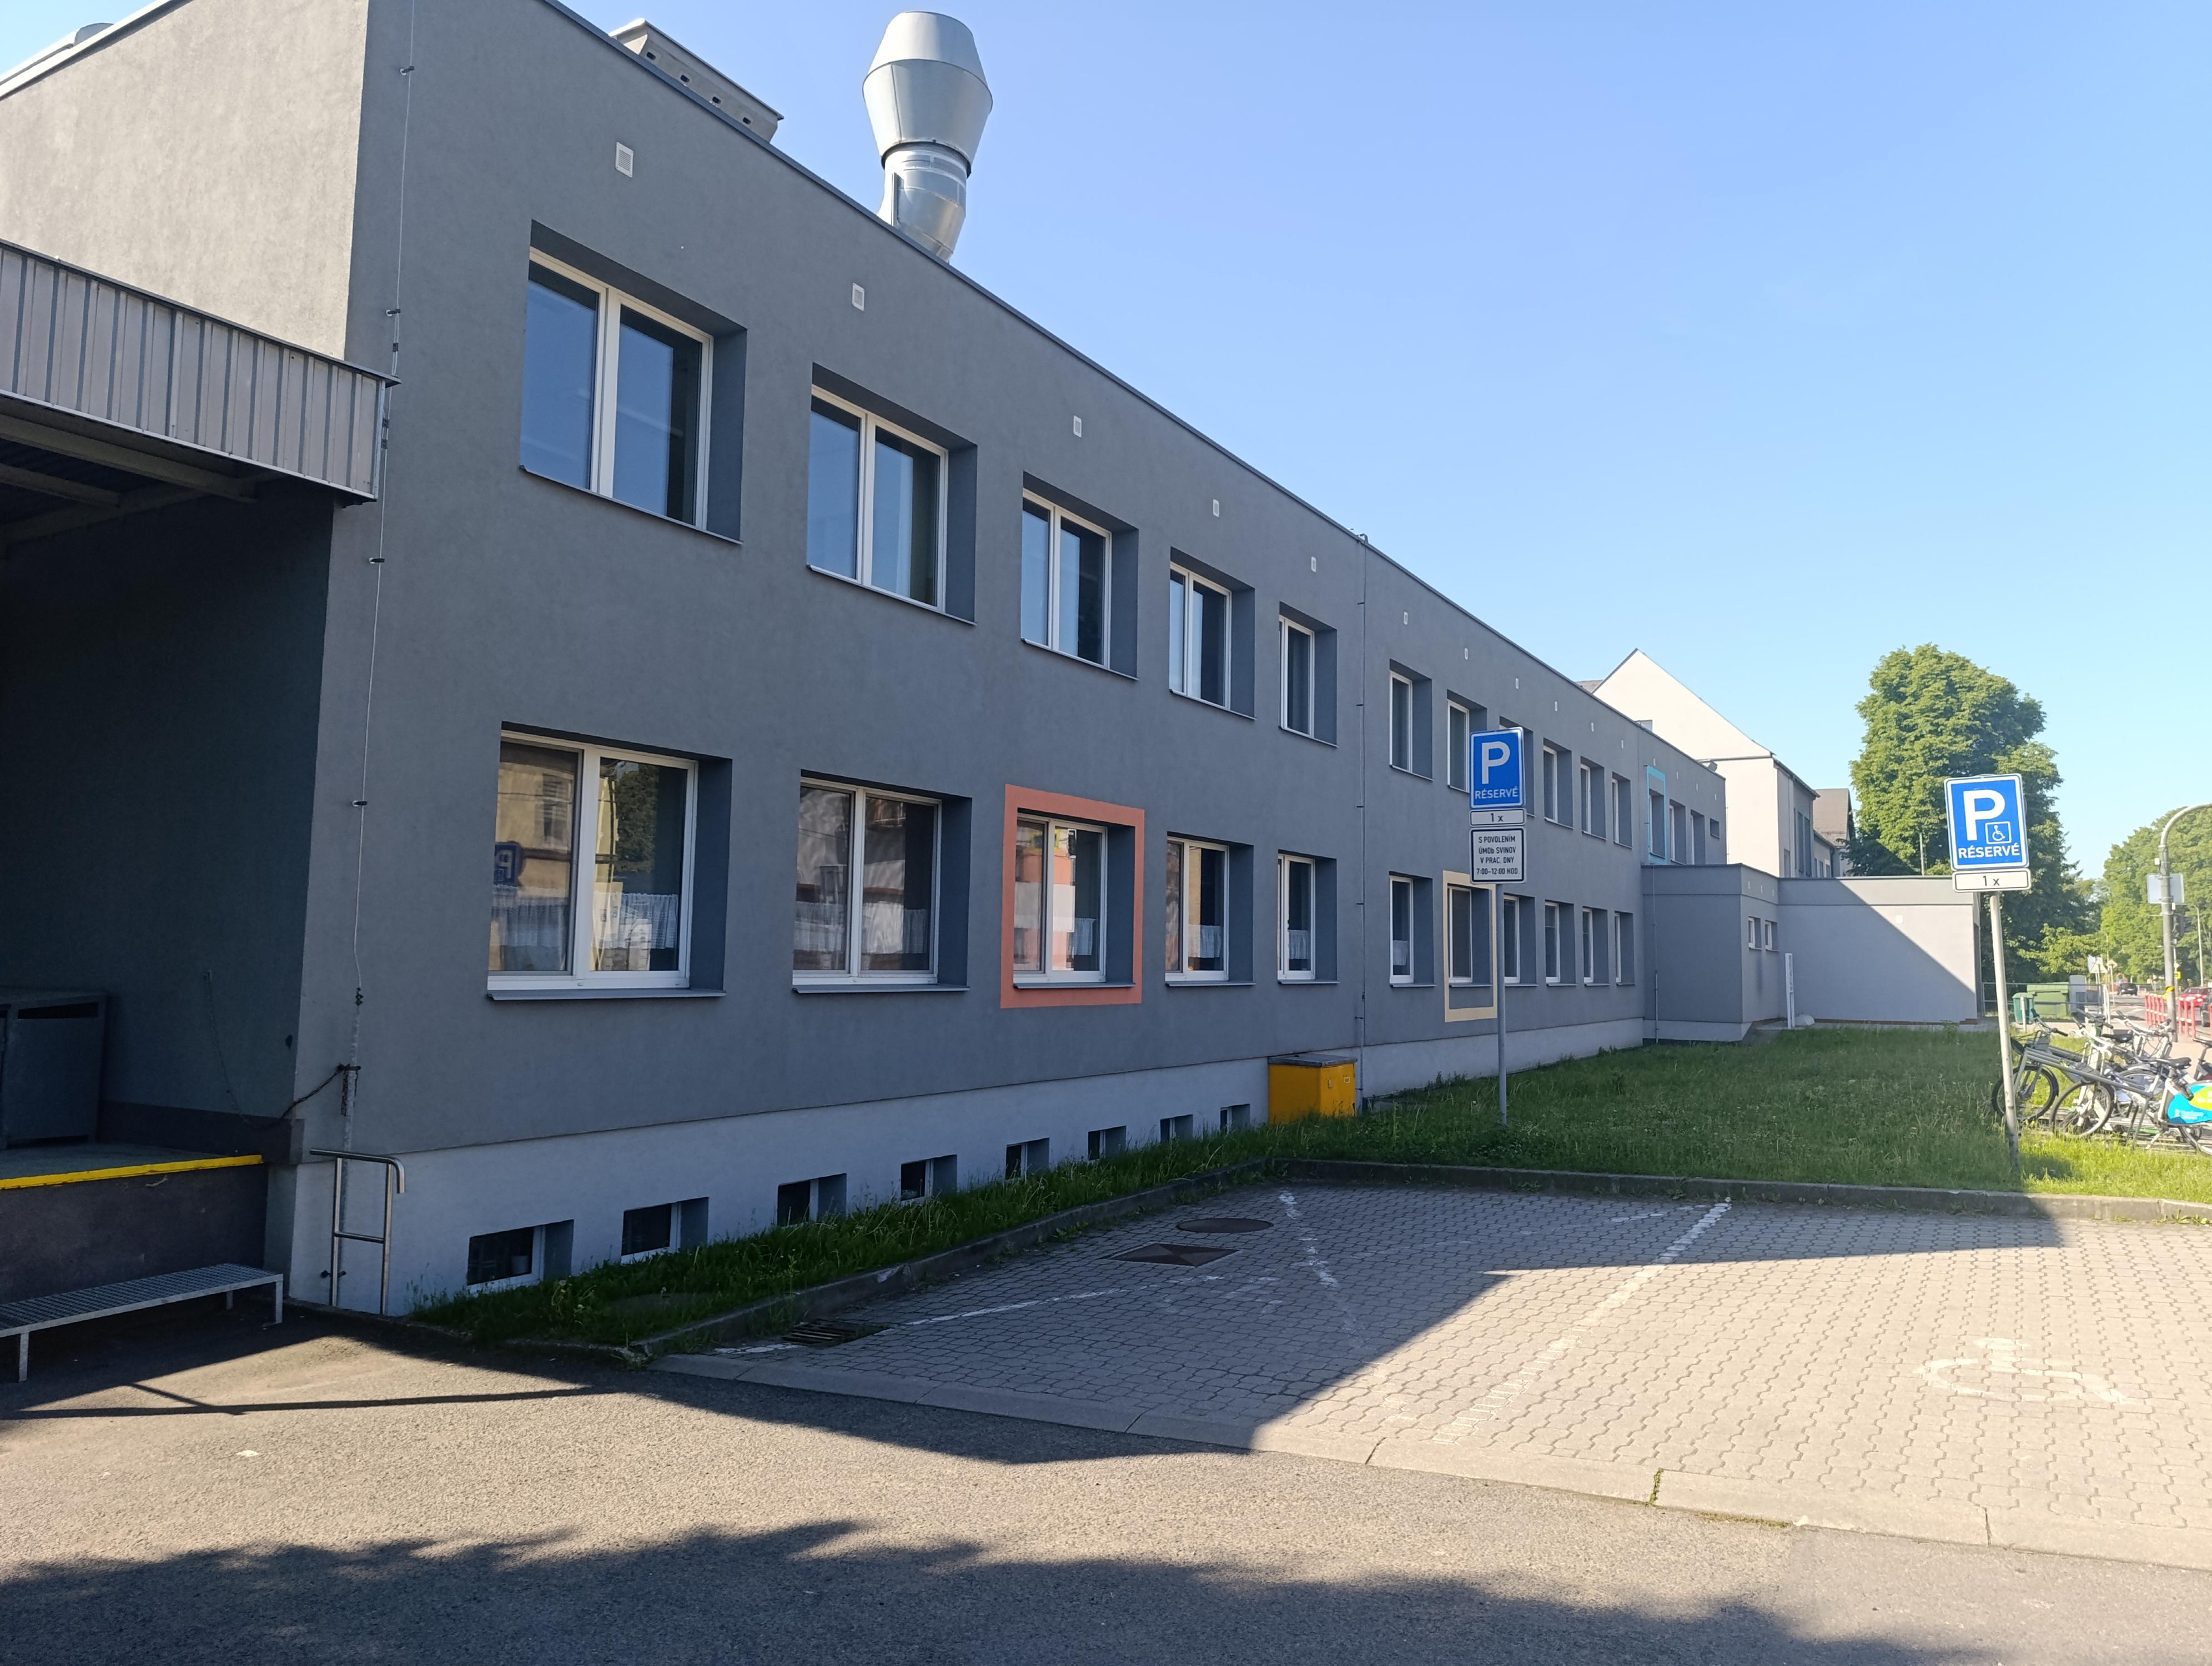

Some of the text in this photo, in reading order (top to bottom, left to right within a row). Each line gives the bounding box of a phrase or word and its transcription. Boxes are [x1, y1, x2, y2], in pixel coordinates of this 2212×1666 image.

[1481, 741, 1510, 784] P
[1475, 786, 1519, 799] RÉSERVÉ
[1490, 812, 1494, 822] 1
[1963, 789, 2005, 841] P
[1484, 834, 1515, 843] POVOLENÍM
[1479, 845, 1495, 854] ÚMOb
[1958, 842, 2020, 859] RÉSERVÉ
[1982, 875, 1988, 886] 1
